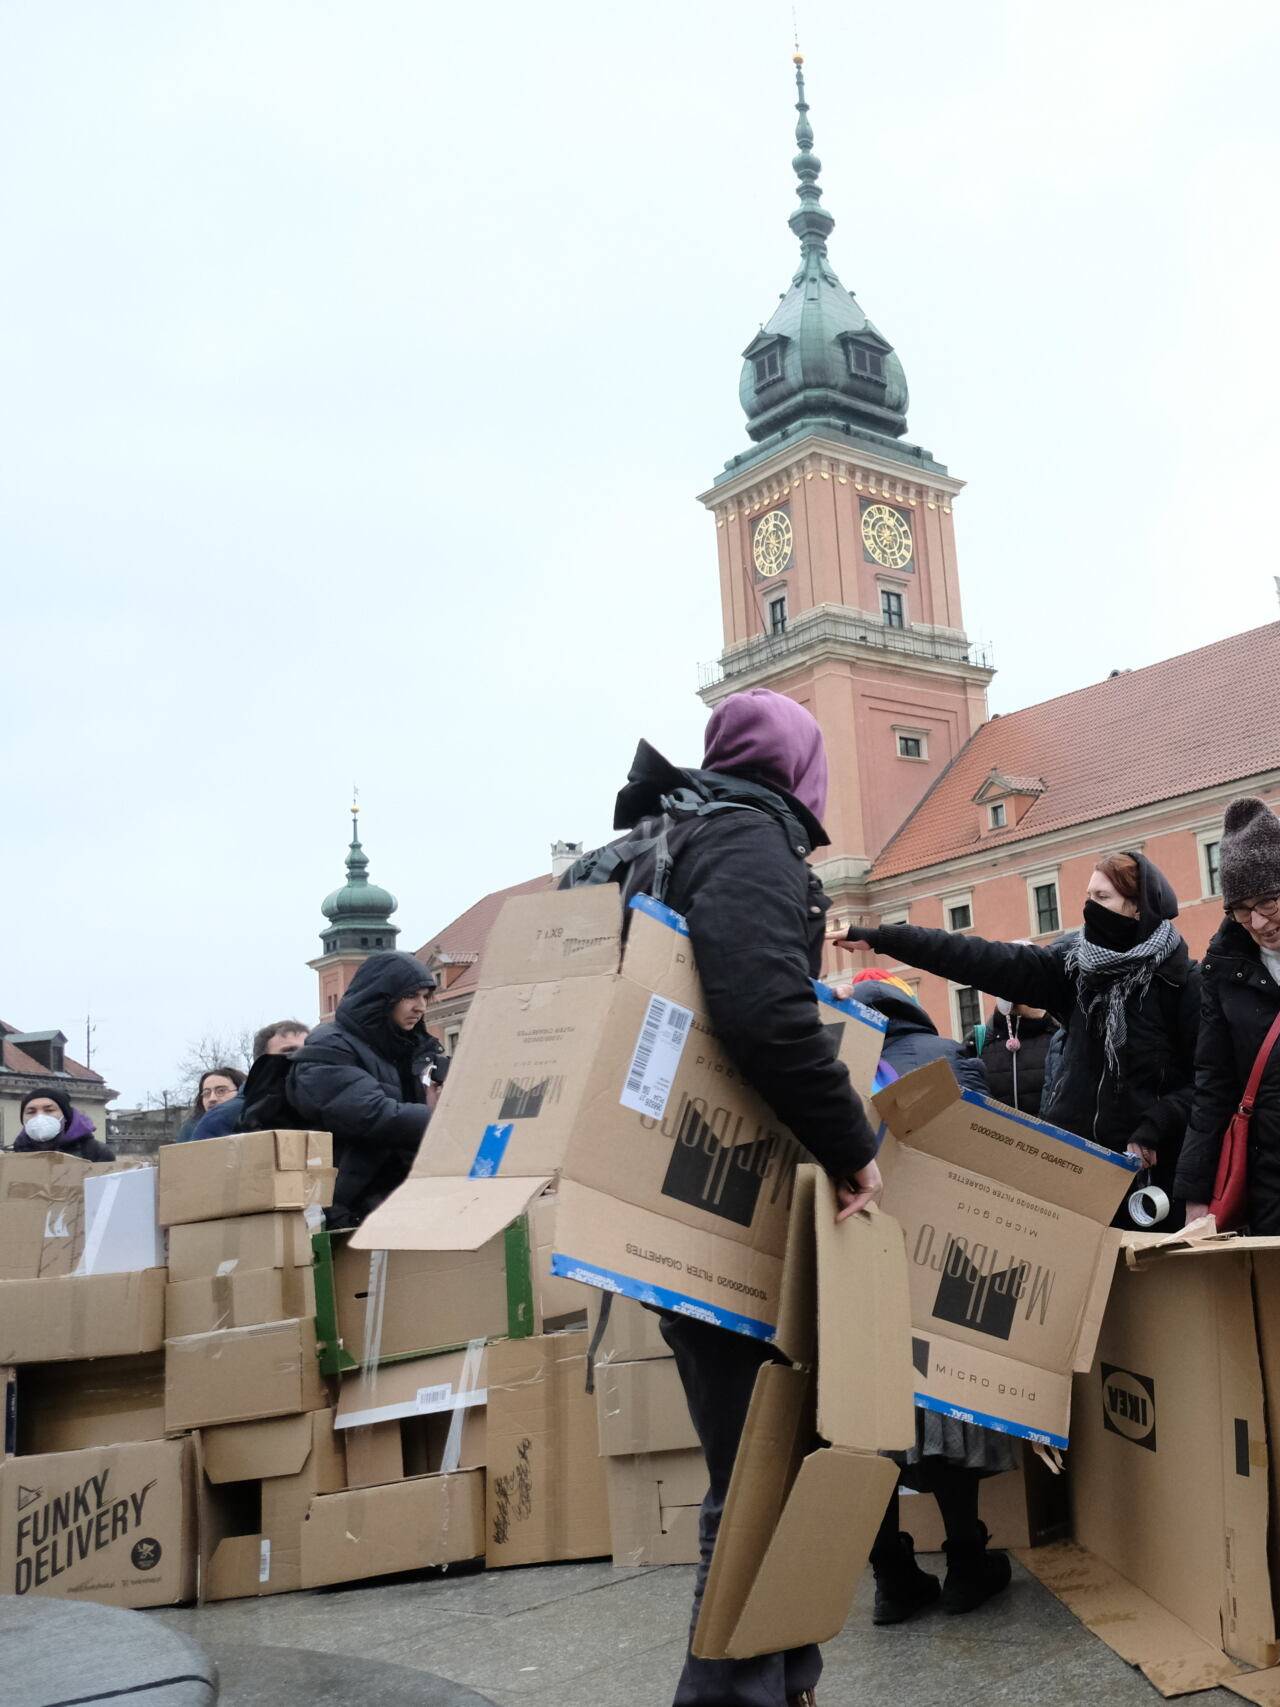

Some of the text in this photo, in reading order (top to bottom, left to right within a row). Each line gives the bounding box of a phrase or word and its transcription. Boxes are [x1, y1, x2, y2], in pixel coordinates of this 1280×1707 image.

[1015, 1141, 1039, 1157] FILTER
[1040, 1152, 1084, 1175] CIGARETTES
[947, 1170, 991, 1194] CIGARETTES
[991, 1188, 1016, 1203] FILTER
[957, 1202, 1038, 1238] MICRO gold
[625, 1243, 683, 1271] CIGARETTES
[686, 1262, 713, 1282] FILTER
[913, 1223, 1056, 1326] Marlboro
[936, 1362, 1036, 1402] MICRO gold
[1107, 1385, 1148, 1426] IKEA
[16, 1467, 111, 1558] FUNKY
[15, 1478, 158, 1596] DELIVERY
